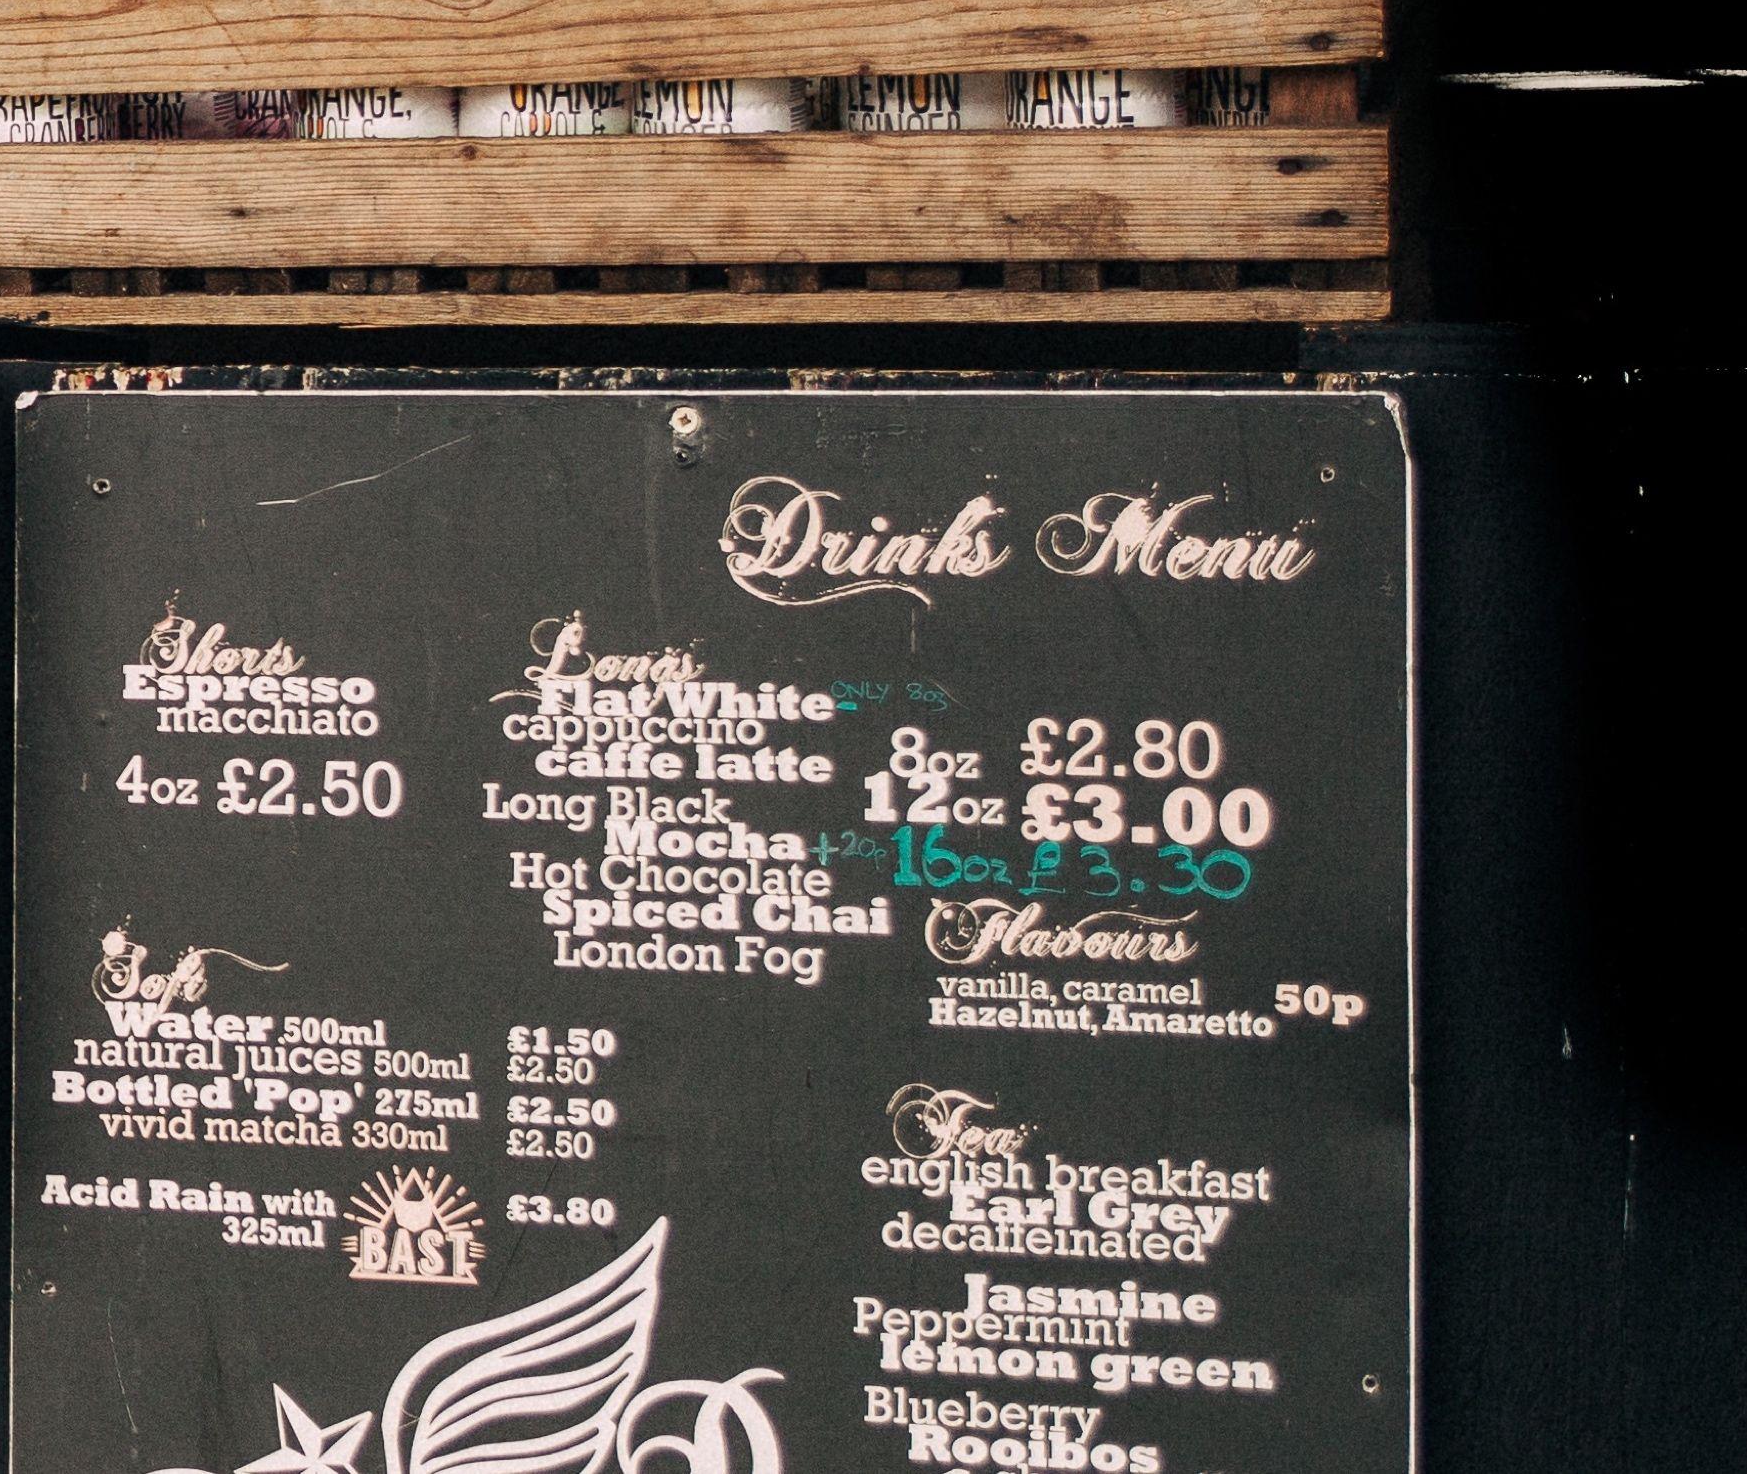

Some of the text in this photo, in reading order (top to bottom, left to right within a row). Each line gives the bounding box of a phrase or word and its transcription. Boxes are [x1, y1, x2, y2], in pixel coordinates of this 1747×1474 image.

[634, 79, 733, 124] LEMON
[847, 73, 961, 114] LEMON
[1005, 69, 1135, 126] ORANGE
[719, 475, 1317, 606] Drinks Menu
[140, 612, 306, 676] Shorts
[122, 663, 377, 713] Espresso
[537, 678, 838, 723] Flat White
[156, 700, 380, 738] macchiato
[502, 712, 766, 752] cappuccino
[534, 740, 837, 783] caffe latte
[887, 716, 1226, 780] 8oz £2.80
[115, 754, 404, 818] 4oz £2.50
[481, 782, 734, 832] Long Black
[862, 770, 1274, 848] 12oz £3.00
[603, 819, 806, 861] Mocha
[890, 823, 1014, 889] 16oz
[509, 851, 832, 897] Hot Chocolate
[542, 887, 893, 937] Spiced Chai
[924, 896, 1200, 966] Flavours
[553, 930, 826, 987] London Fog
[935, 970, 1202, 1007] vanilla, caramel
[1273, 983, 1365, 1026] 50p
[104, 1000, 274, 1044] Water
[506, 1025, 617, 1057] £1.50
[928, 996, 1274, 1039] Hazelnut, Amaretto
[73, 1036, 473, 1081] natural juices 500ml
[506, 1054, 596, 1086] £2.50
[51, 1069, 481, 1122] Bottled 'Pop' 275ml
[506, 1095, 617, 1127] £2.50
[98, 1106, 449, 1152] vivid matcha 330ml
[506, 1128, 596, 1160] £2.50
[885, 1082, 1026, 1160] Tea
[40, 1174, 338, 1218] Acid Rain with
[859, 1149, 1274, 1203] english breakfast
[221, 1216, 326, 1249] 325ml
[506, 1193, 617, 1227] £3.80
[948, 1183, 1231, 1245] Earl Grey
[359, 1225, 476, 1277] BAST
[880, 1210, 1208, 1263] decaffeinated
[852, 1295, 1132, 1349] Peppermint
[962, 1271, 1219, 1324] Jasmine
[879, 1331, 1276, 1393] lemon green
[863, 1384, 1102, 1444] Blueberry
[907, 1422, 1161, 1474] Rooibos
